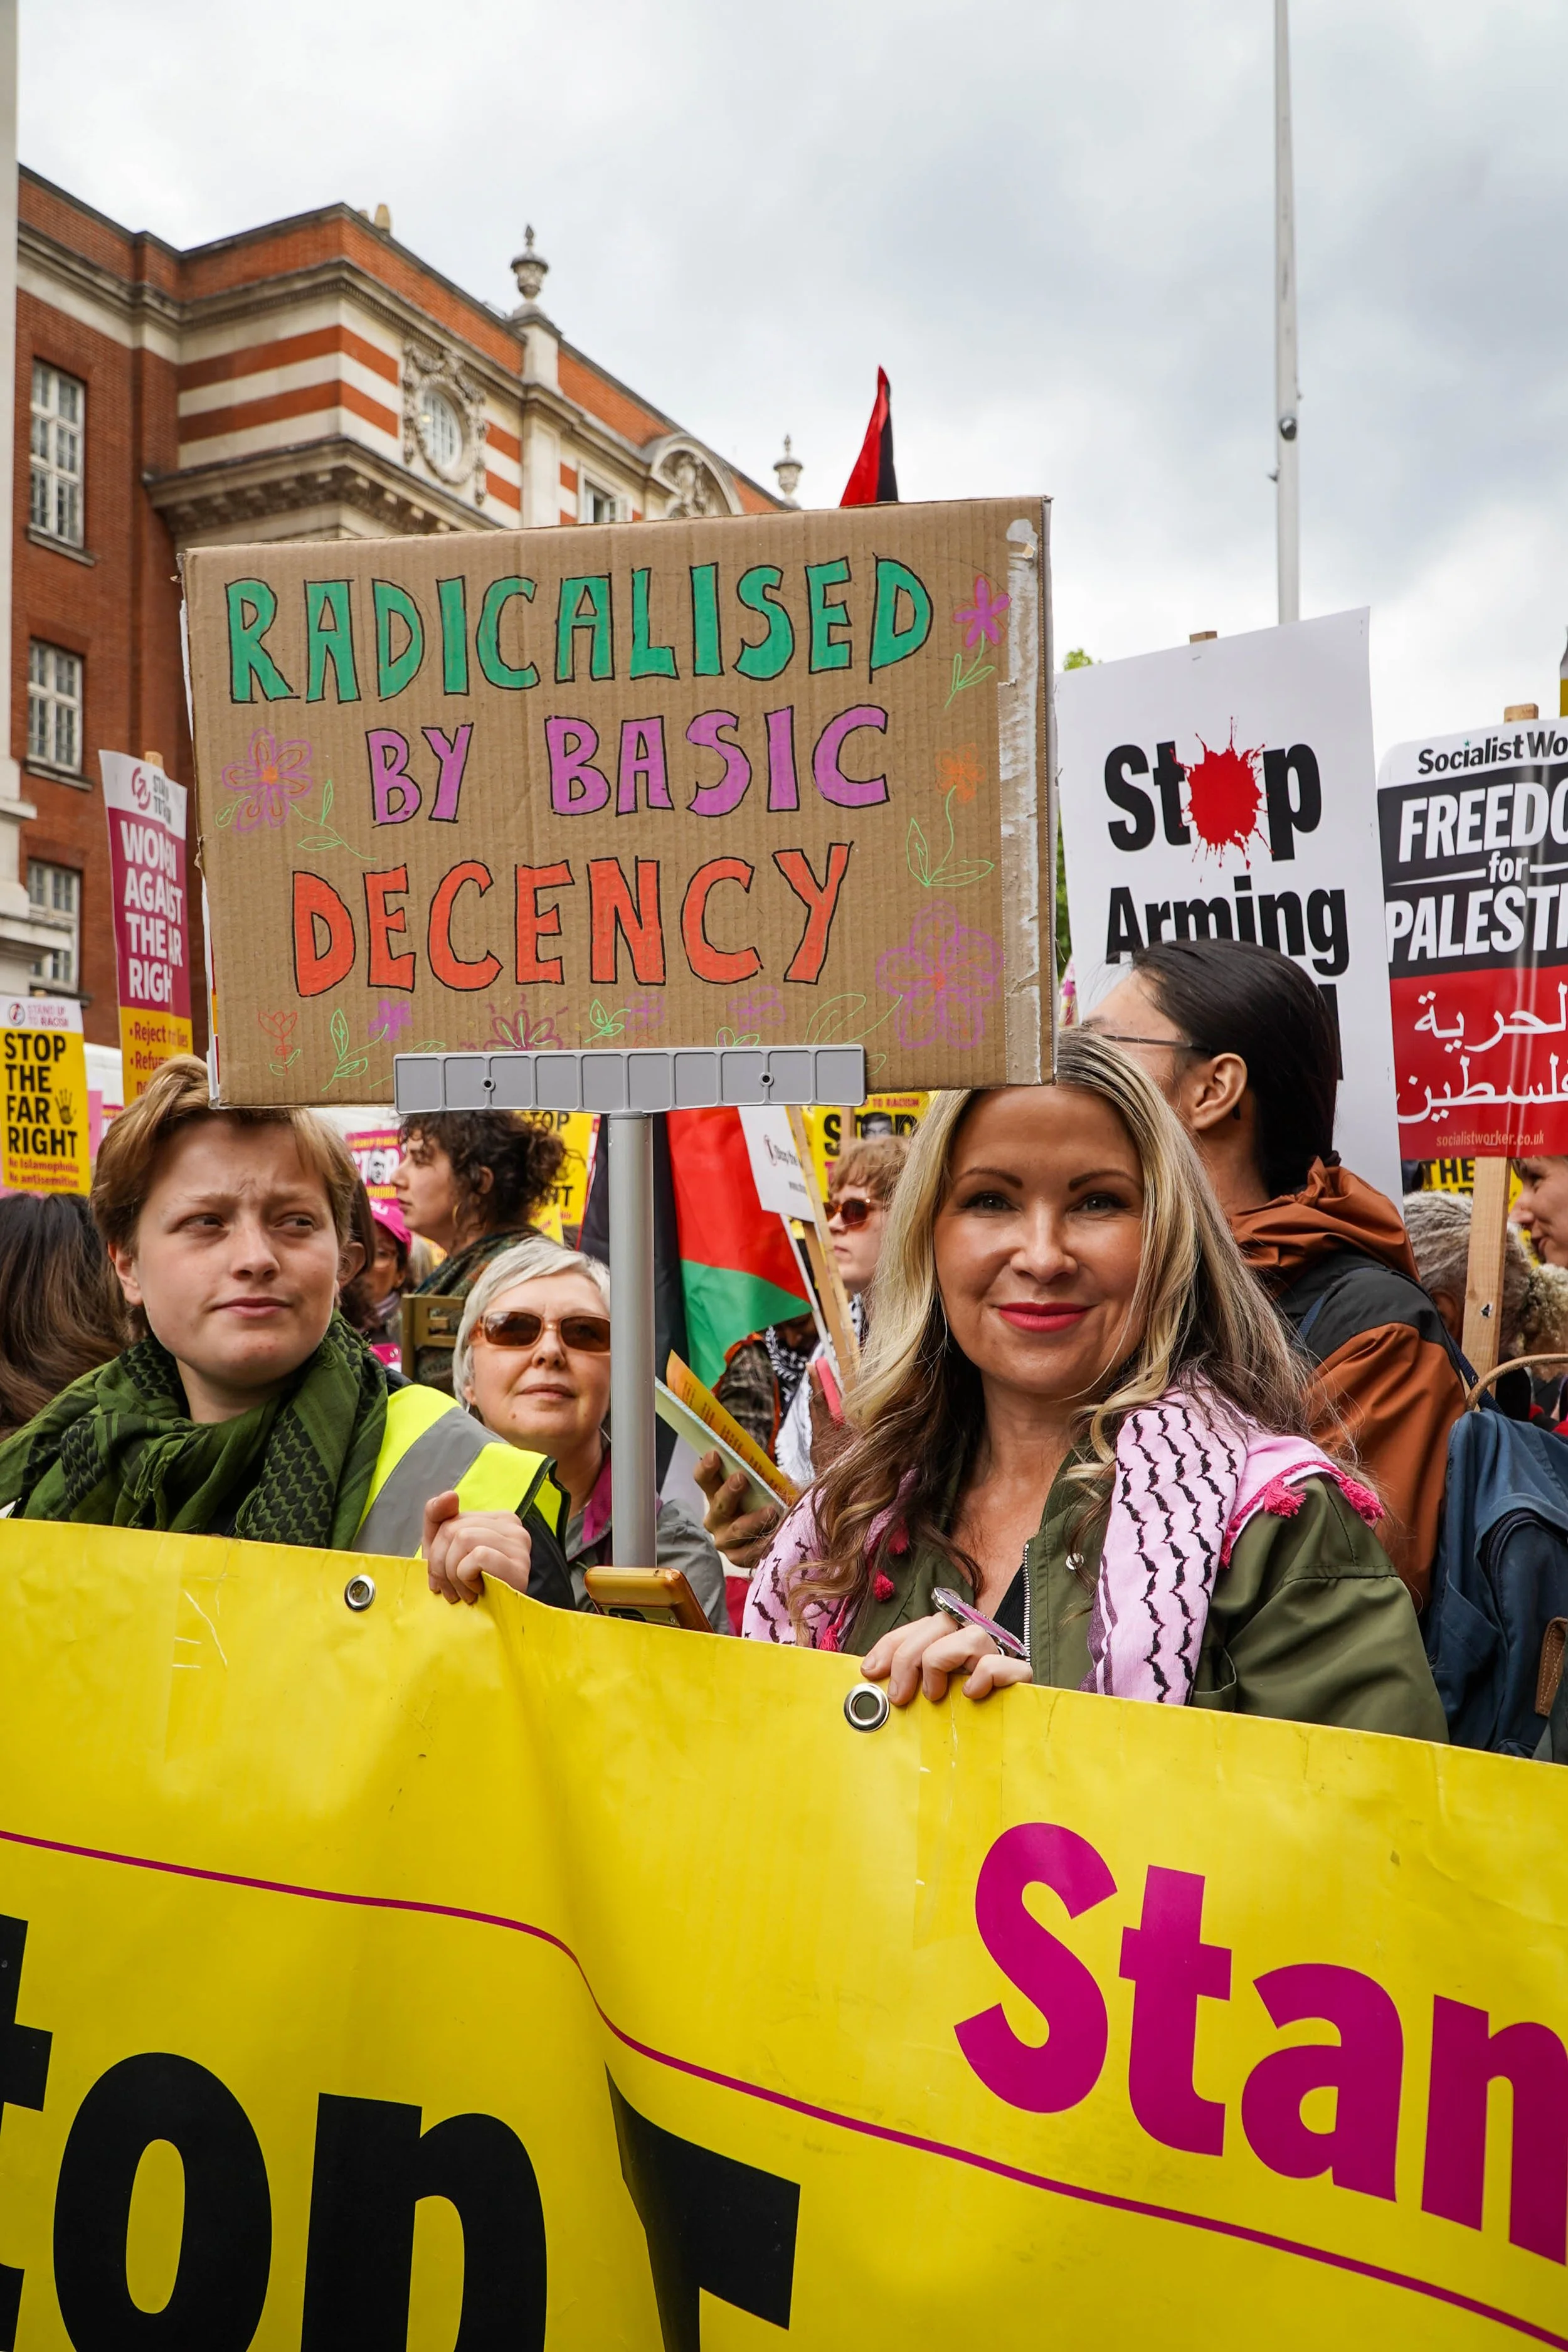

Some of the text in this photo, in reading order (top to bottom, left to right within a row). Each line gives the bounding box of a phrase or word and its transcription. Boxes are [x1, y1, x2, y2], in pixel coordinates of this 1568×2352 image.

[225, 553, 933, 704] RADICALISED
[365, 704, 890, 827] BY BASIC
[1417, 733, 1524, 775] Socialist
[1489, 850, 1528, 883] for
[125, 912, 167, 960] THE
[292, 840, 853, 997] DECENCY
[1106, 875, 1349, 976] Arming
[129, 958, 172, 1003] RIGH
[4, 1032, 66, 1062] STOP
[5, 1064, 51, 1093] THE
[7, 1095, 51, 1125] FAR
[8, 1126, 78, 1158] RIGHT
[1436, 1130, 1545, 1147] socialistworker.co.uk
[954, 1822, 1568, 2267] Stan
